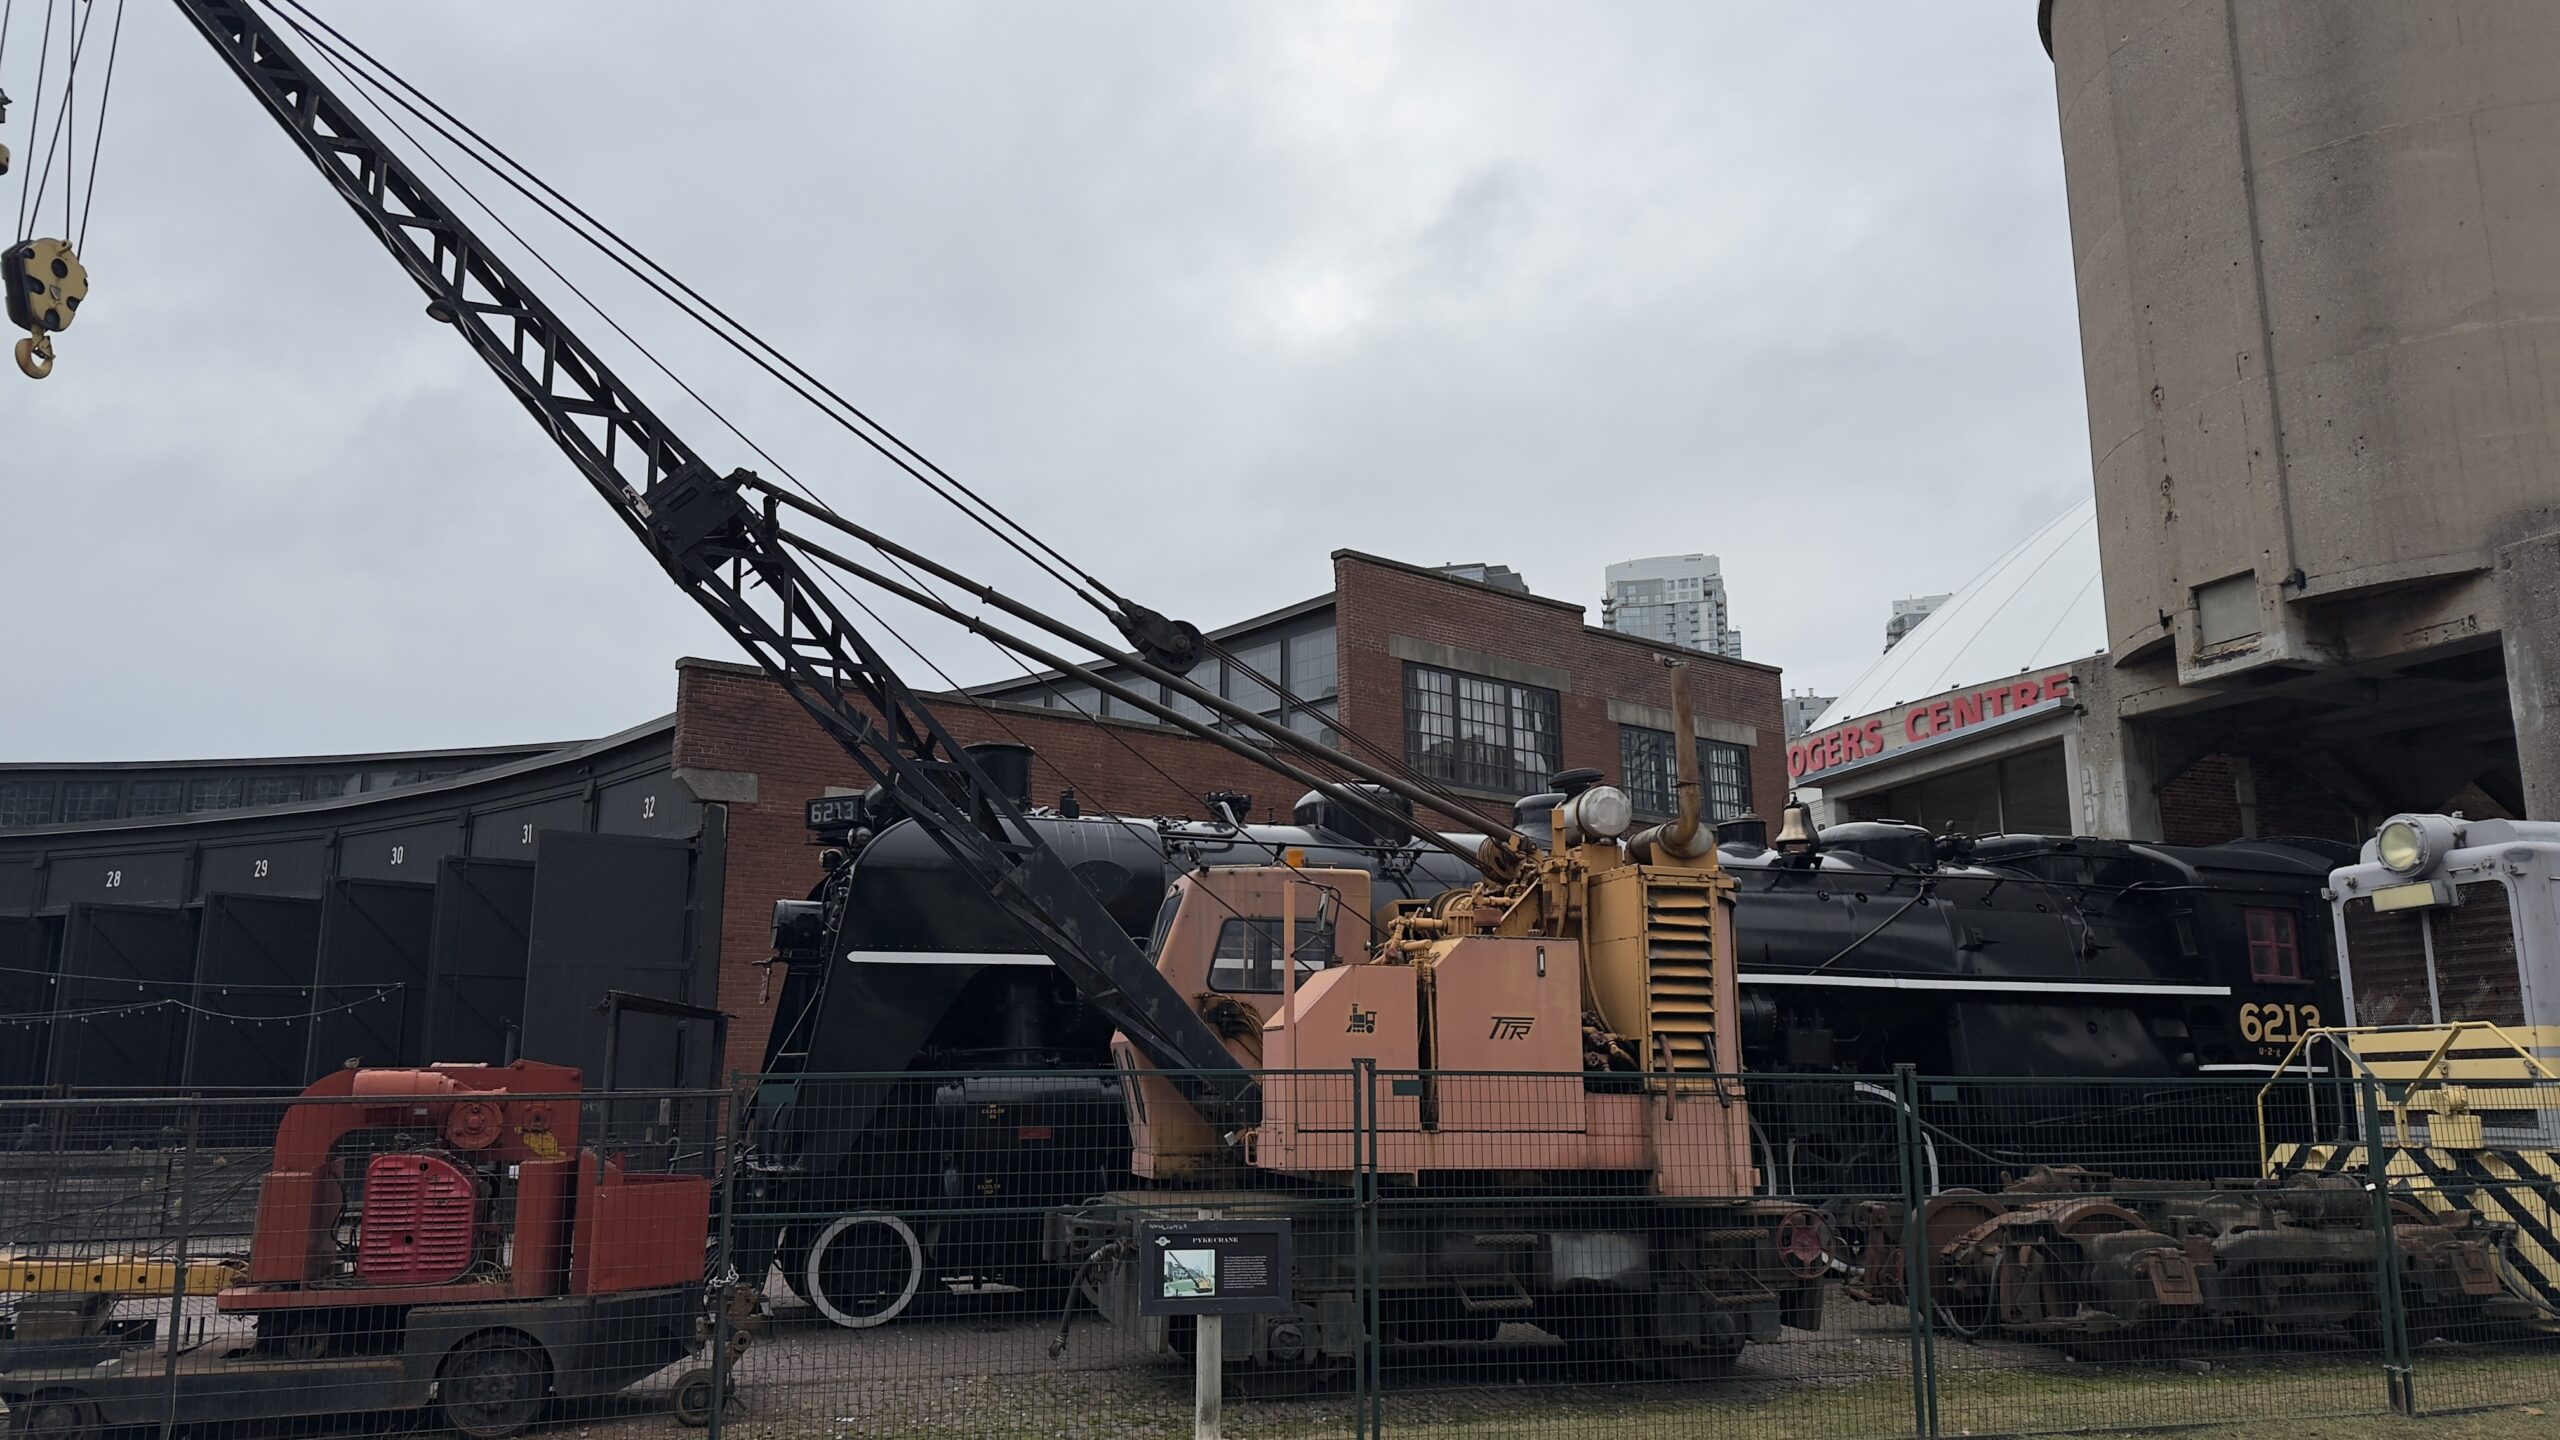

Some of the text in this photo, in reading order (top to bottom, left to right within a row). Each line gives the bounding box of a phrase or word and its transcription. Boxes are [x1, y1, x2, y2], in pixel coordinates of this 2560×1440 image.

[1787, 719, 1884, 778] OGERS
[643, 795, 656, 819] 32
[811, 801, 854, 823] 6213
[522, 823, 533, 844] 31
[390, 846, 404, 865] 30
[106, 870, 121, 888] 28
[253, 859, 268, 878] 29
[1489, 1016, 1536, 1041] TTR
[2239, 1002, 2321, 1044] 6213
